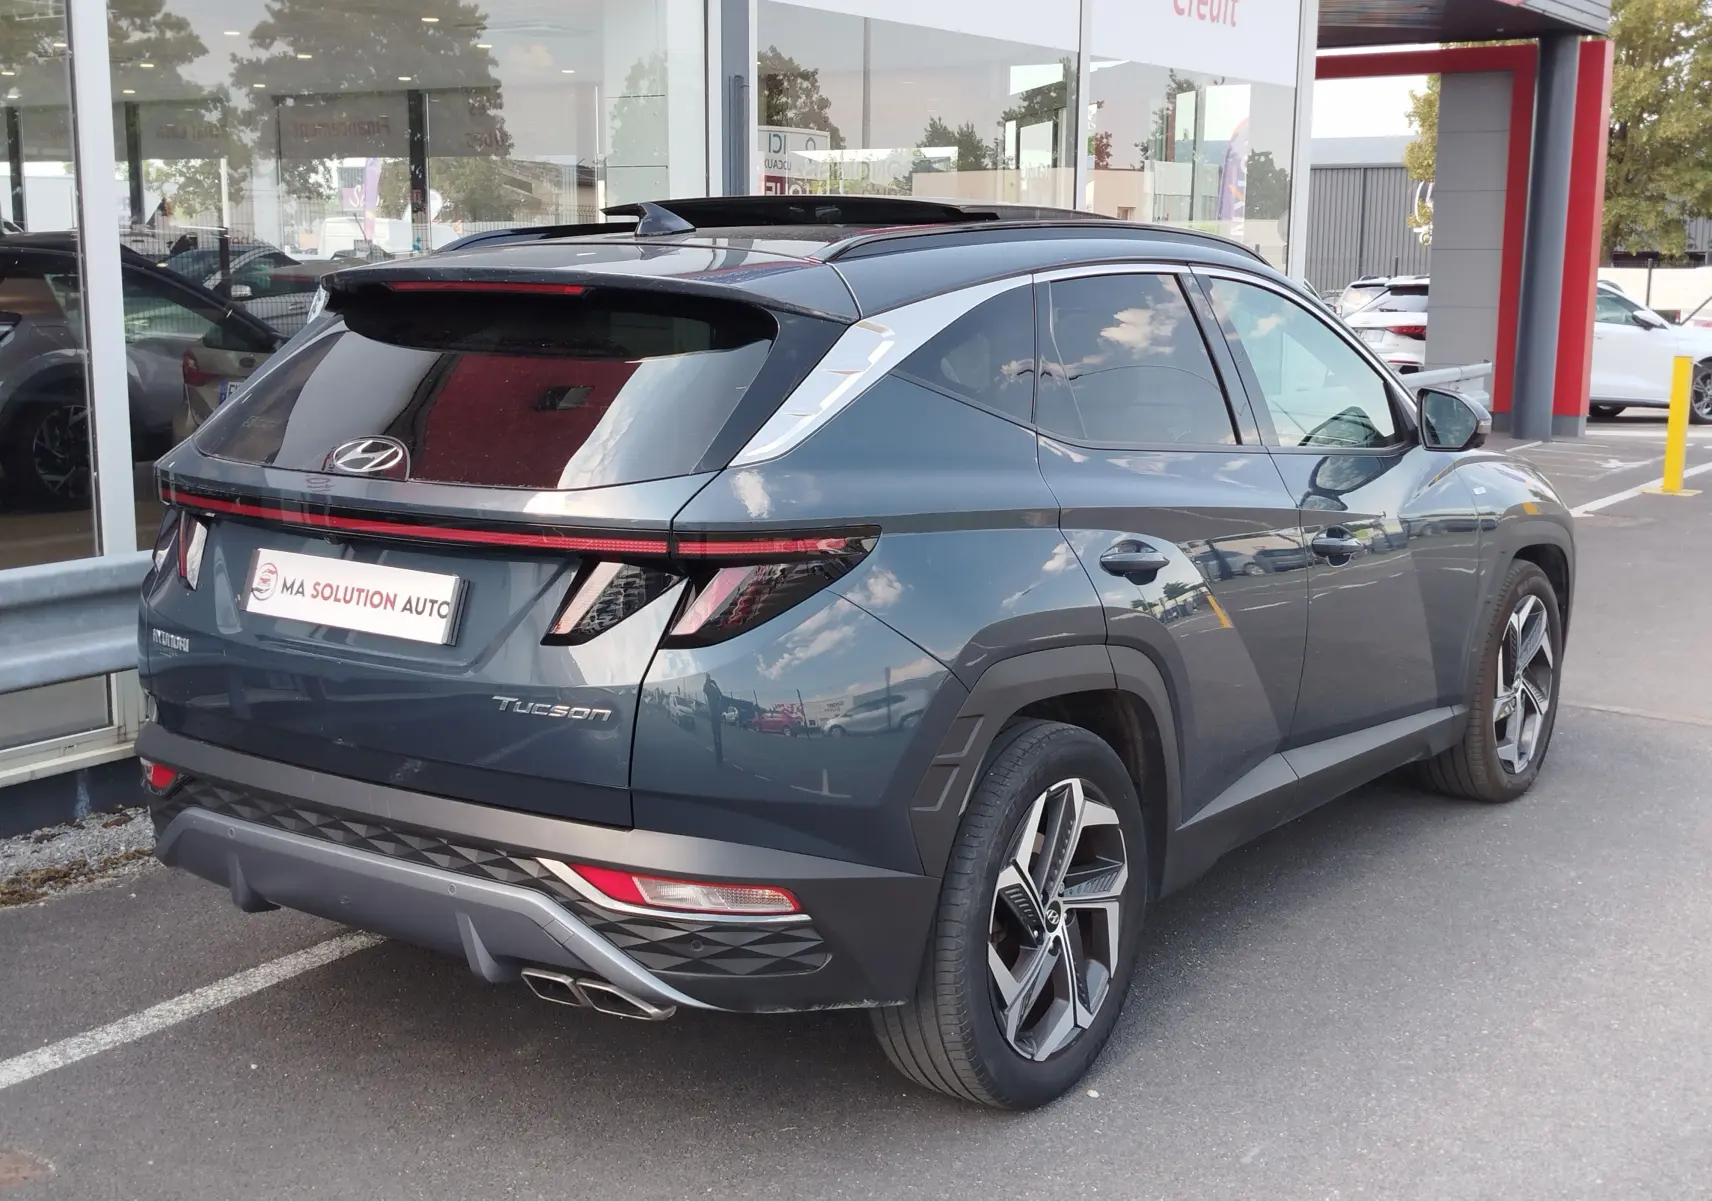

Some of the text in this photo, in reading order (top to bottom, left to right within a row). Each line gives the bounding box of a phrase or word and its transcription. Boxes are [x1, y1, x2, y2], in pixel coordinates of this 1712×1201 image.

[281, 576, 450, 619] MA SOLUTION AUTO
[152, 628, 189, 653] HYUNDAI
